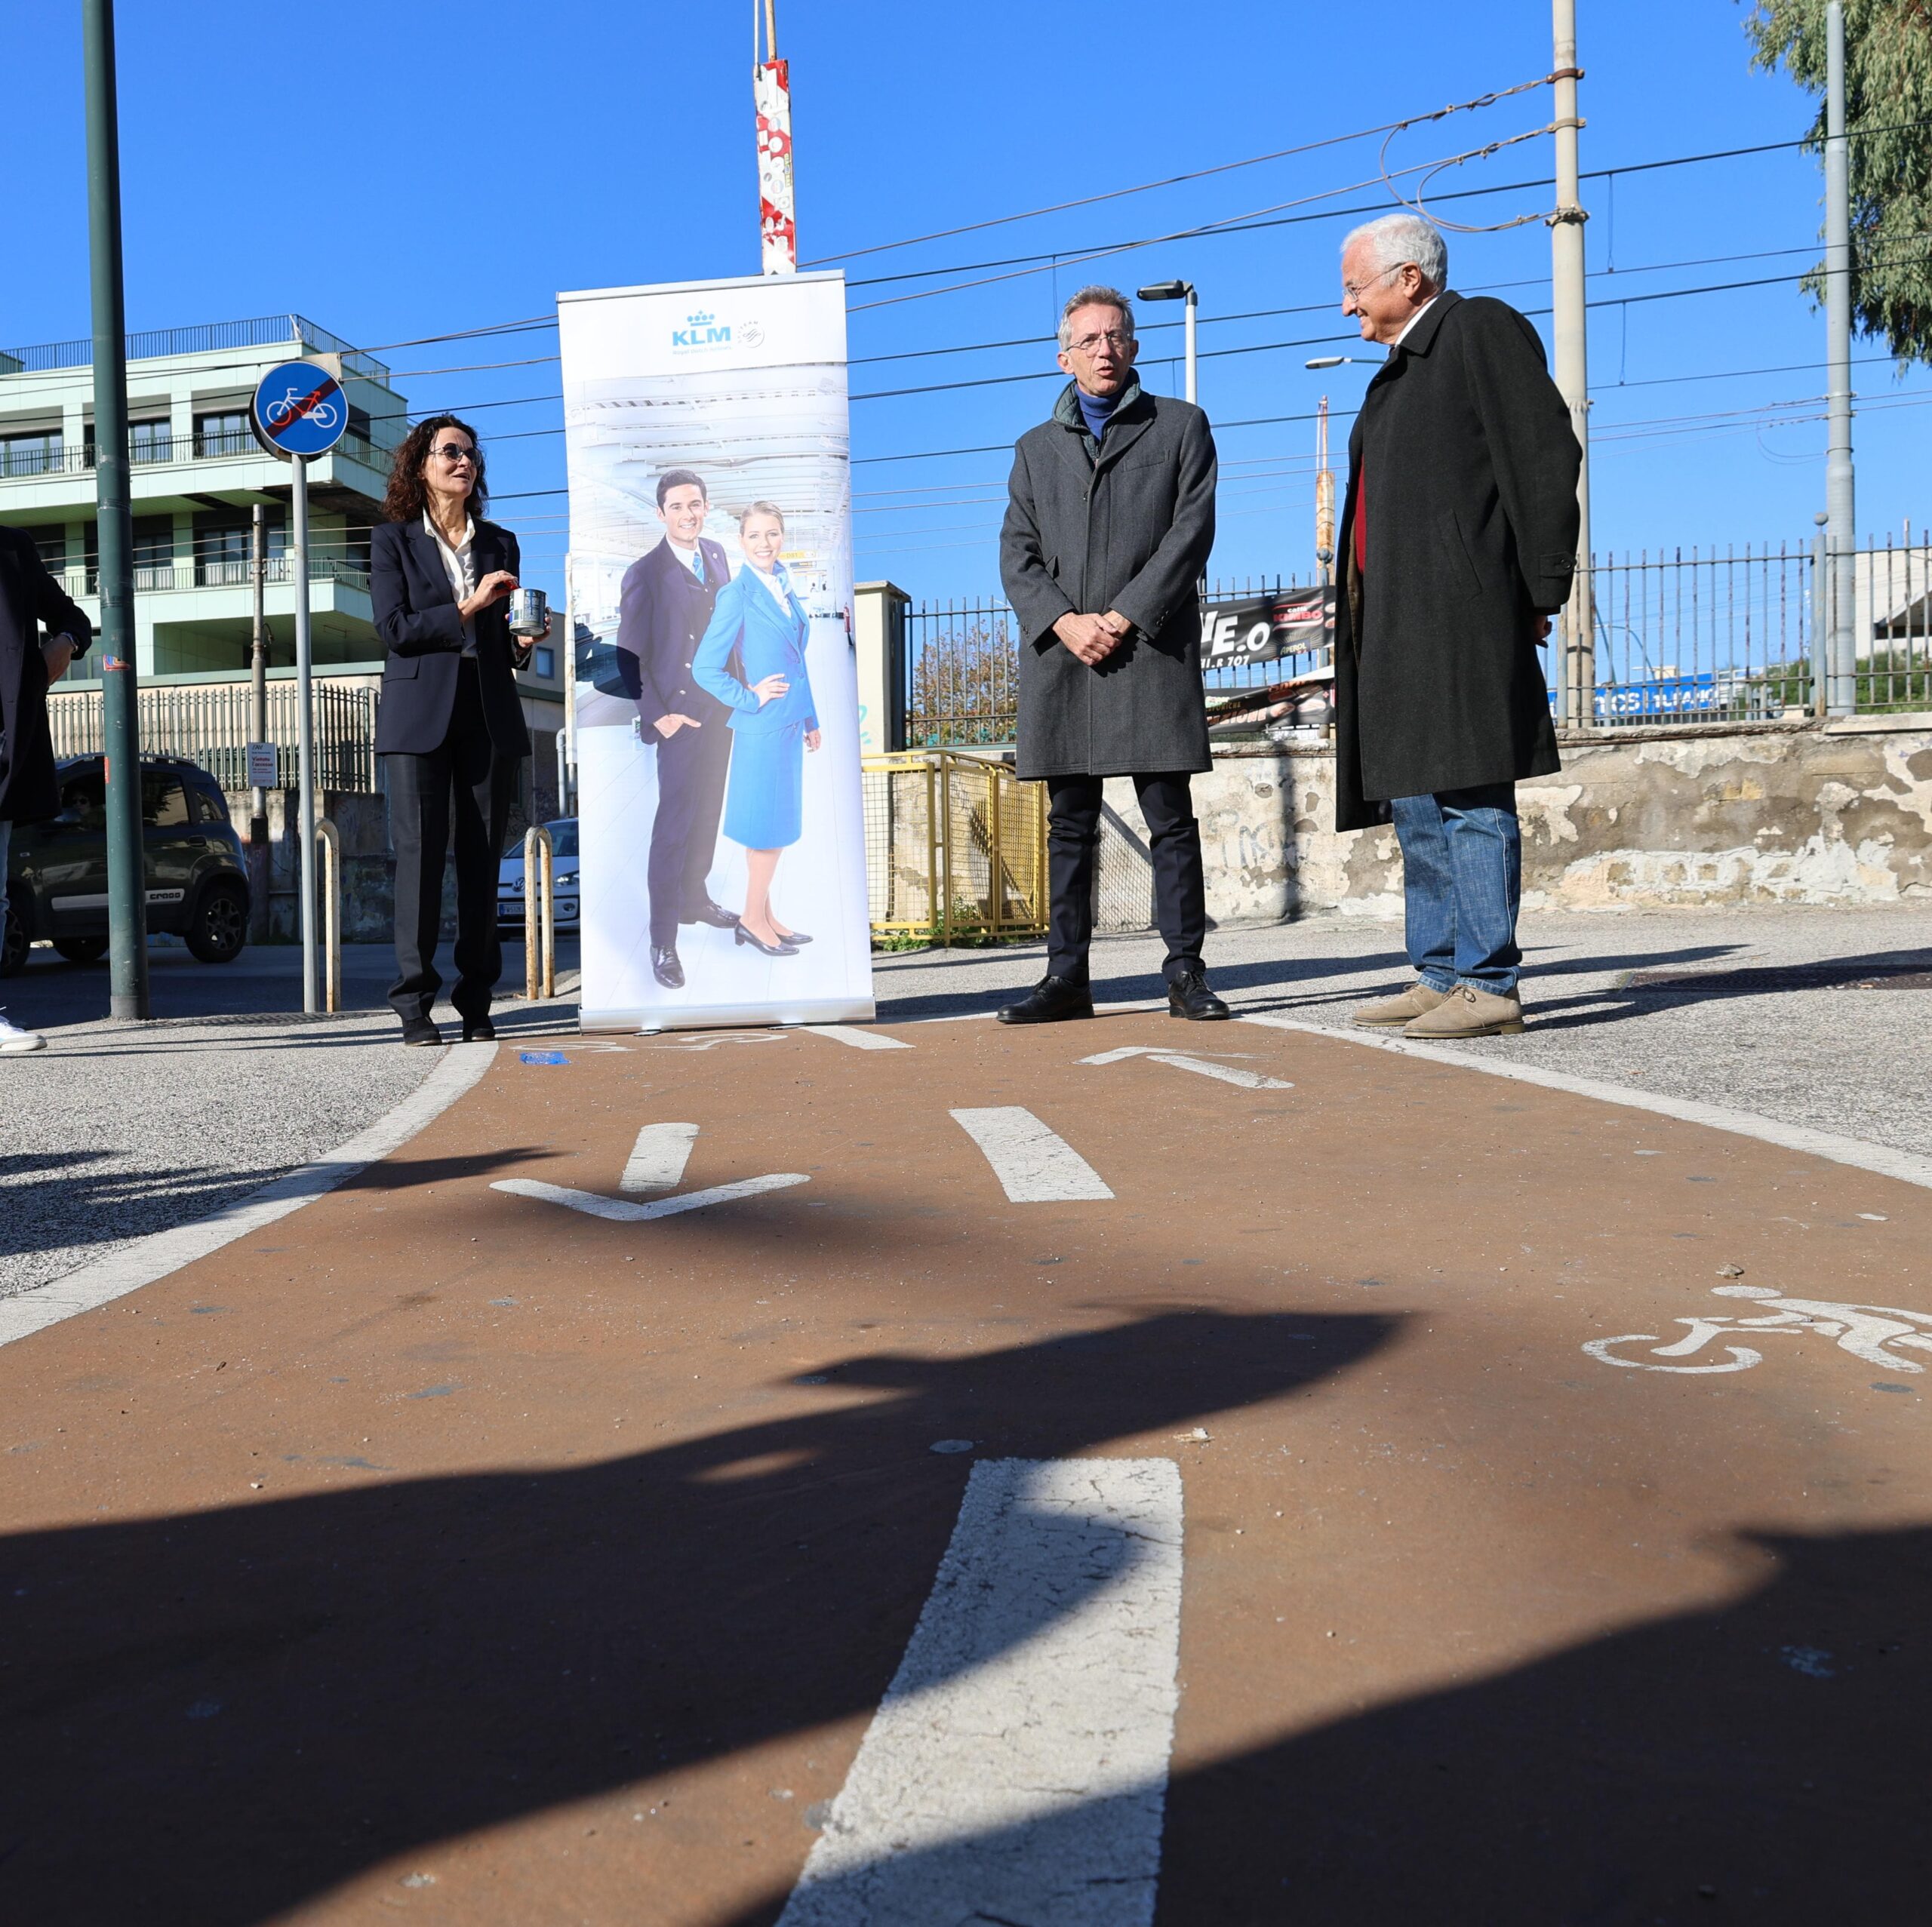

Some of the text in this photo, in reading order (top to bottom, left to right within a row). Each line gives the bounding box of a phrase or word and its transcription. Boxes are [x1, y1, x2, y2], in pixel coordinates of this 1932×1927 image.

[672, 327, 731, 346] KLM
[1273, 610, 1323, 622] KIMBO
[1281, 642, 1306, 654] APEROL
